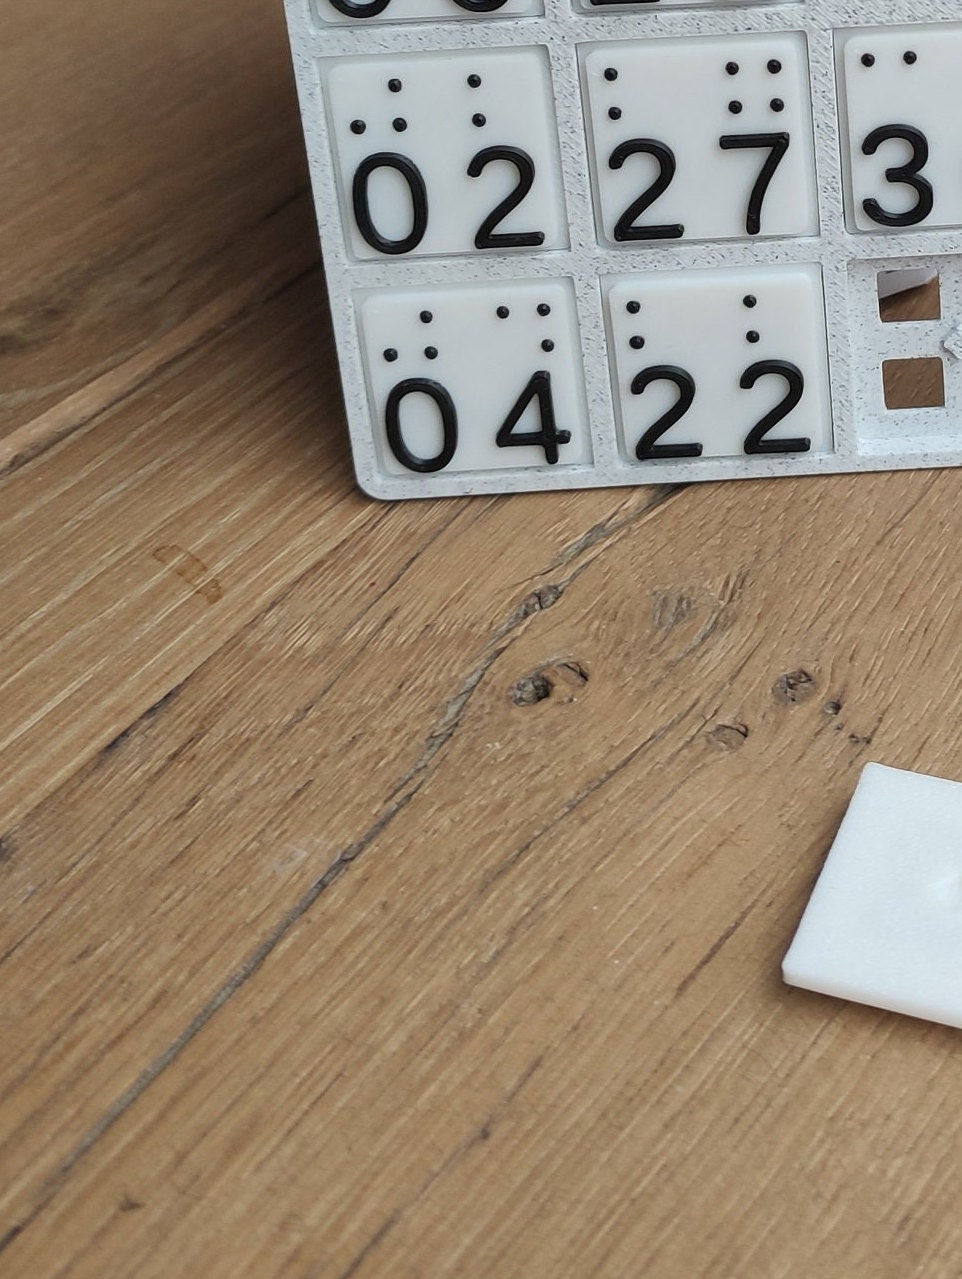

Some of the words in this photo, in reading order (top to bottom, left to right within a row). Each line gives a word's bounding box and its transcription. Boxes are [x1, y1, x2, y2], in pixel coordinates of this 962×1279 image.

[350, 143, 546, 257] 02
[607, 130, 791, 244] 27
[383, 369, 573, 475] 04
[629, 358, 813, 464] 22
